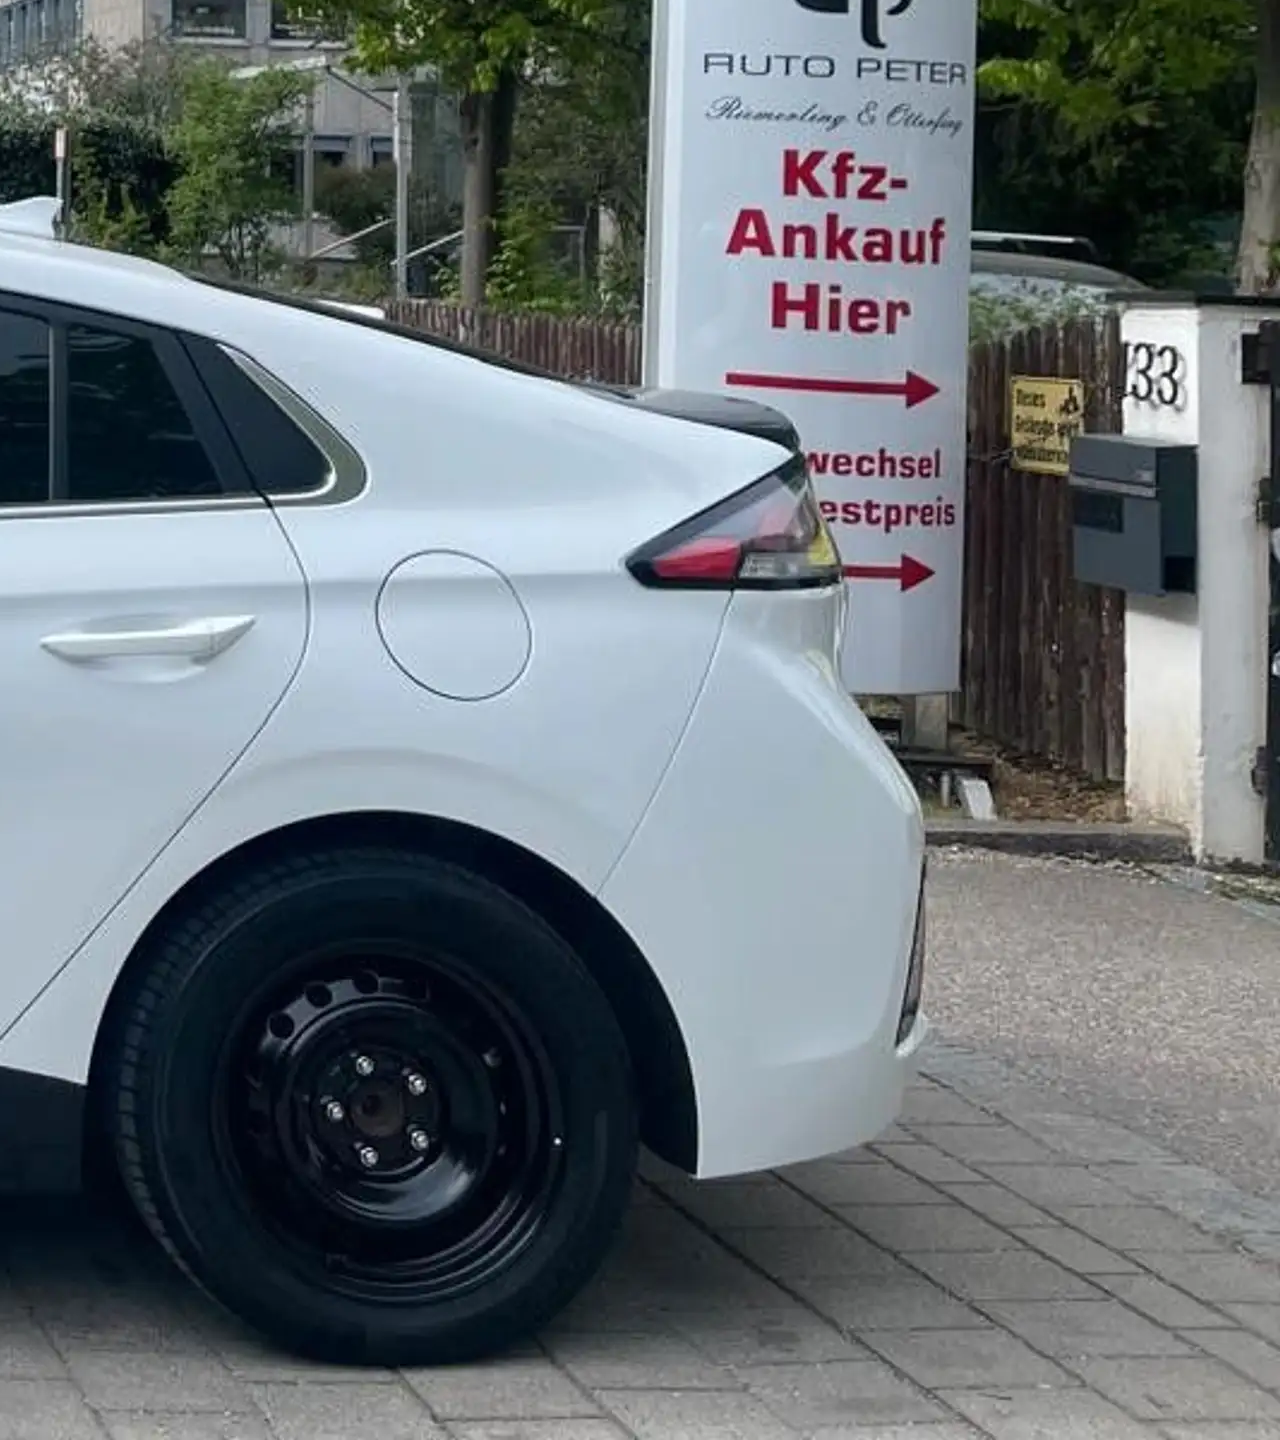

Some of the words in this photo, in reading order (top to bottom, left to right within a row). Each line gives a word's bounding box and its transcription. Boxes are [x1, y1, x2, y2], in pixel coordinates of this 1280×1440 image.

[703, 52, 836, 79] AUTO
[856, 57, 967, 86] PETER
[856, 101, 879, 127] &
[782, 148, 908, 200] Kfz-
[725, 208, 946, 265] Ankauf
[771, 281, 912, 335] Hier
[806, 446, 942, 479] wechsel
[818, 495, 956, 534] estpreis
